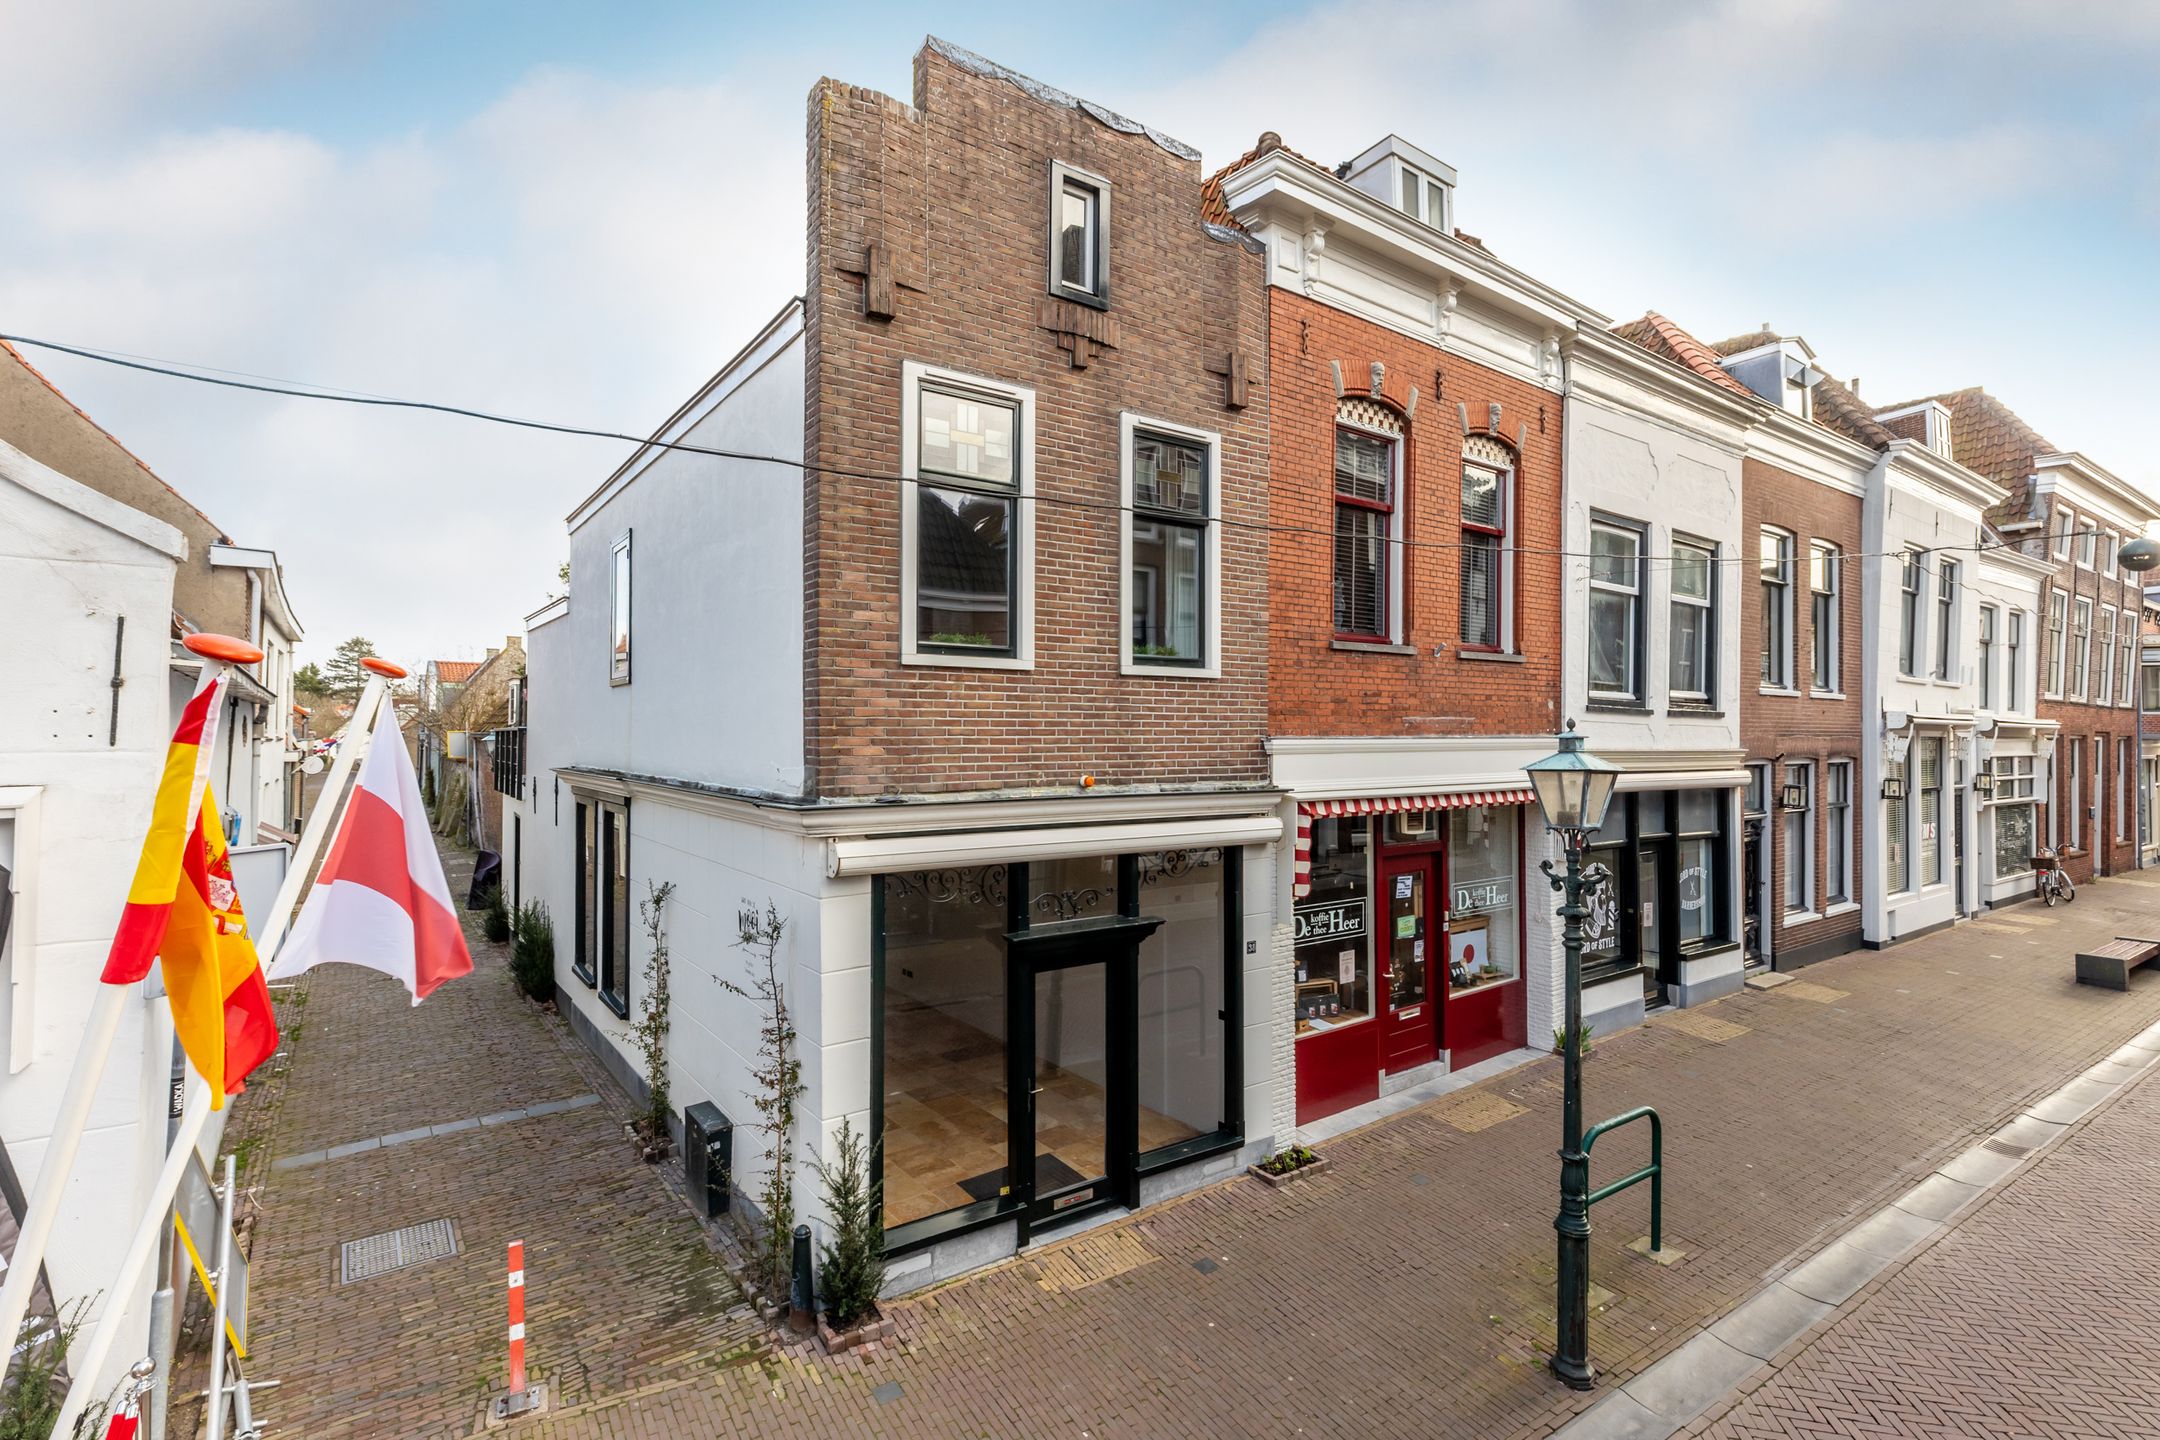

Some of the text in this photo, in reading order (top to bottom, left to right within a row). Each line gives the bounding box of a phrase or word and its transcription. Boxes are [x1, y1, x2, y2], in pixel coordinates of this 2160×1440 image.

[1457, 885, 1508, 910] De Heer
[1294, 909, 1360, 939] De Heer
[1311, 912, 1329, 923] koffie
[1313, 925, 1327, 935] thee
[1591, 942, 1598, 951] OF
[1599, 937, 1615, 950] STYLE
